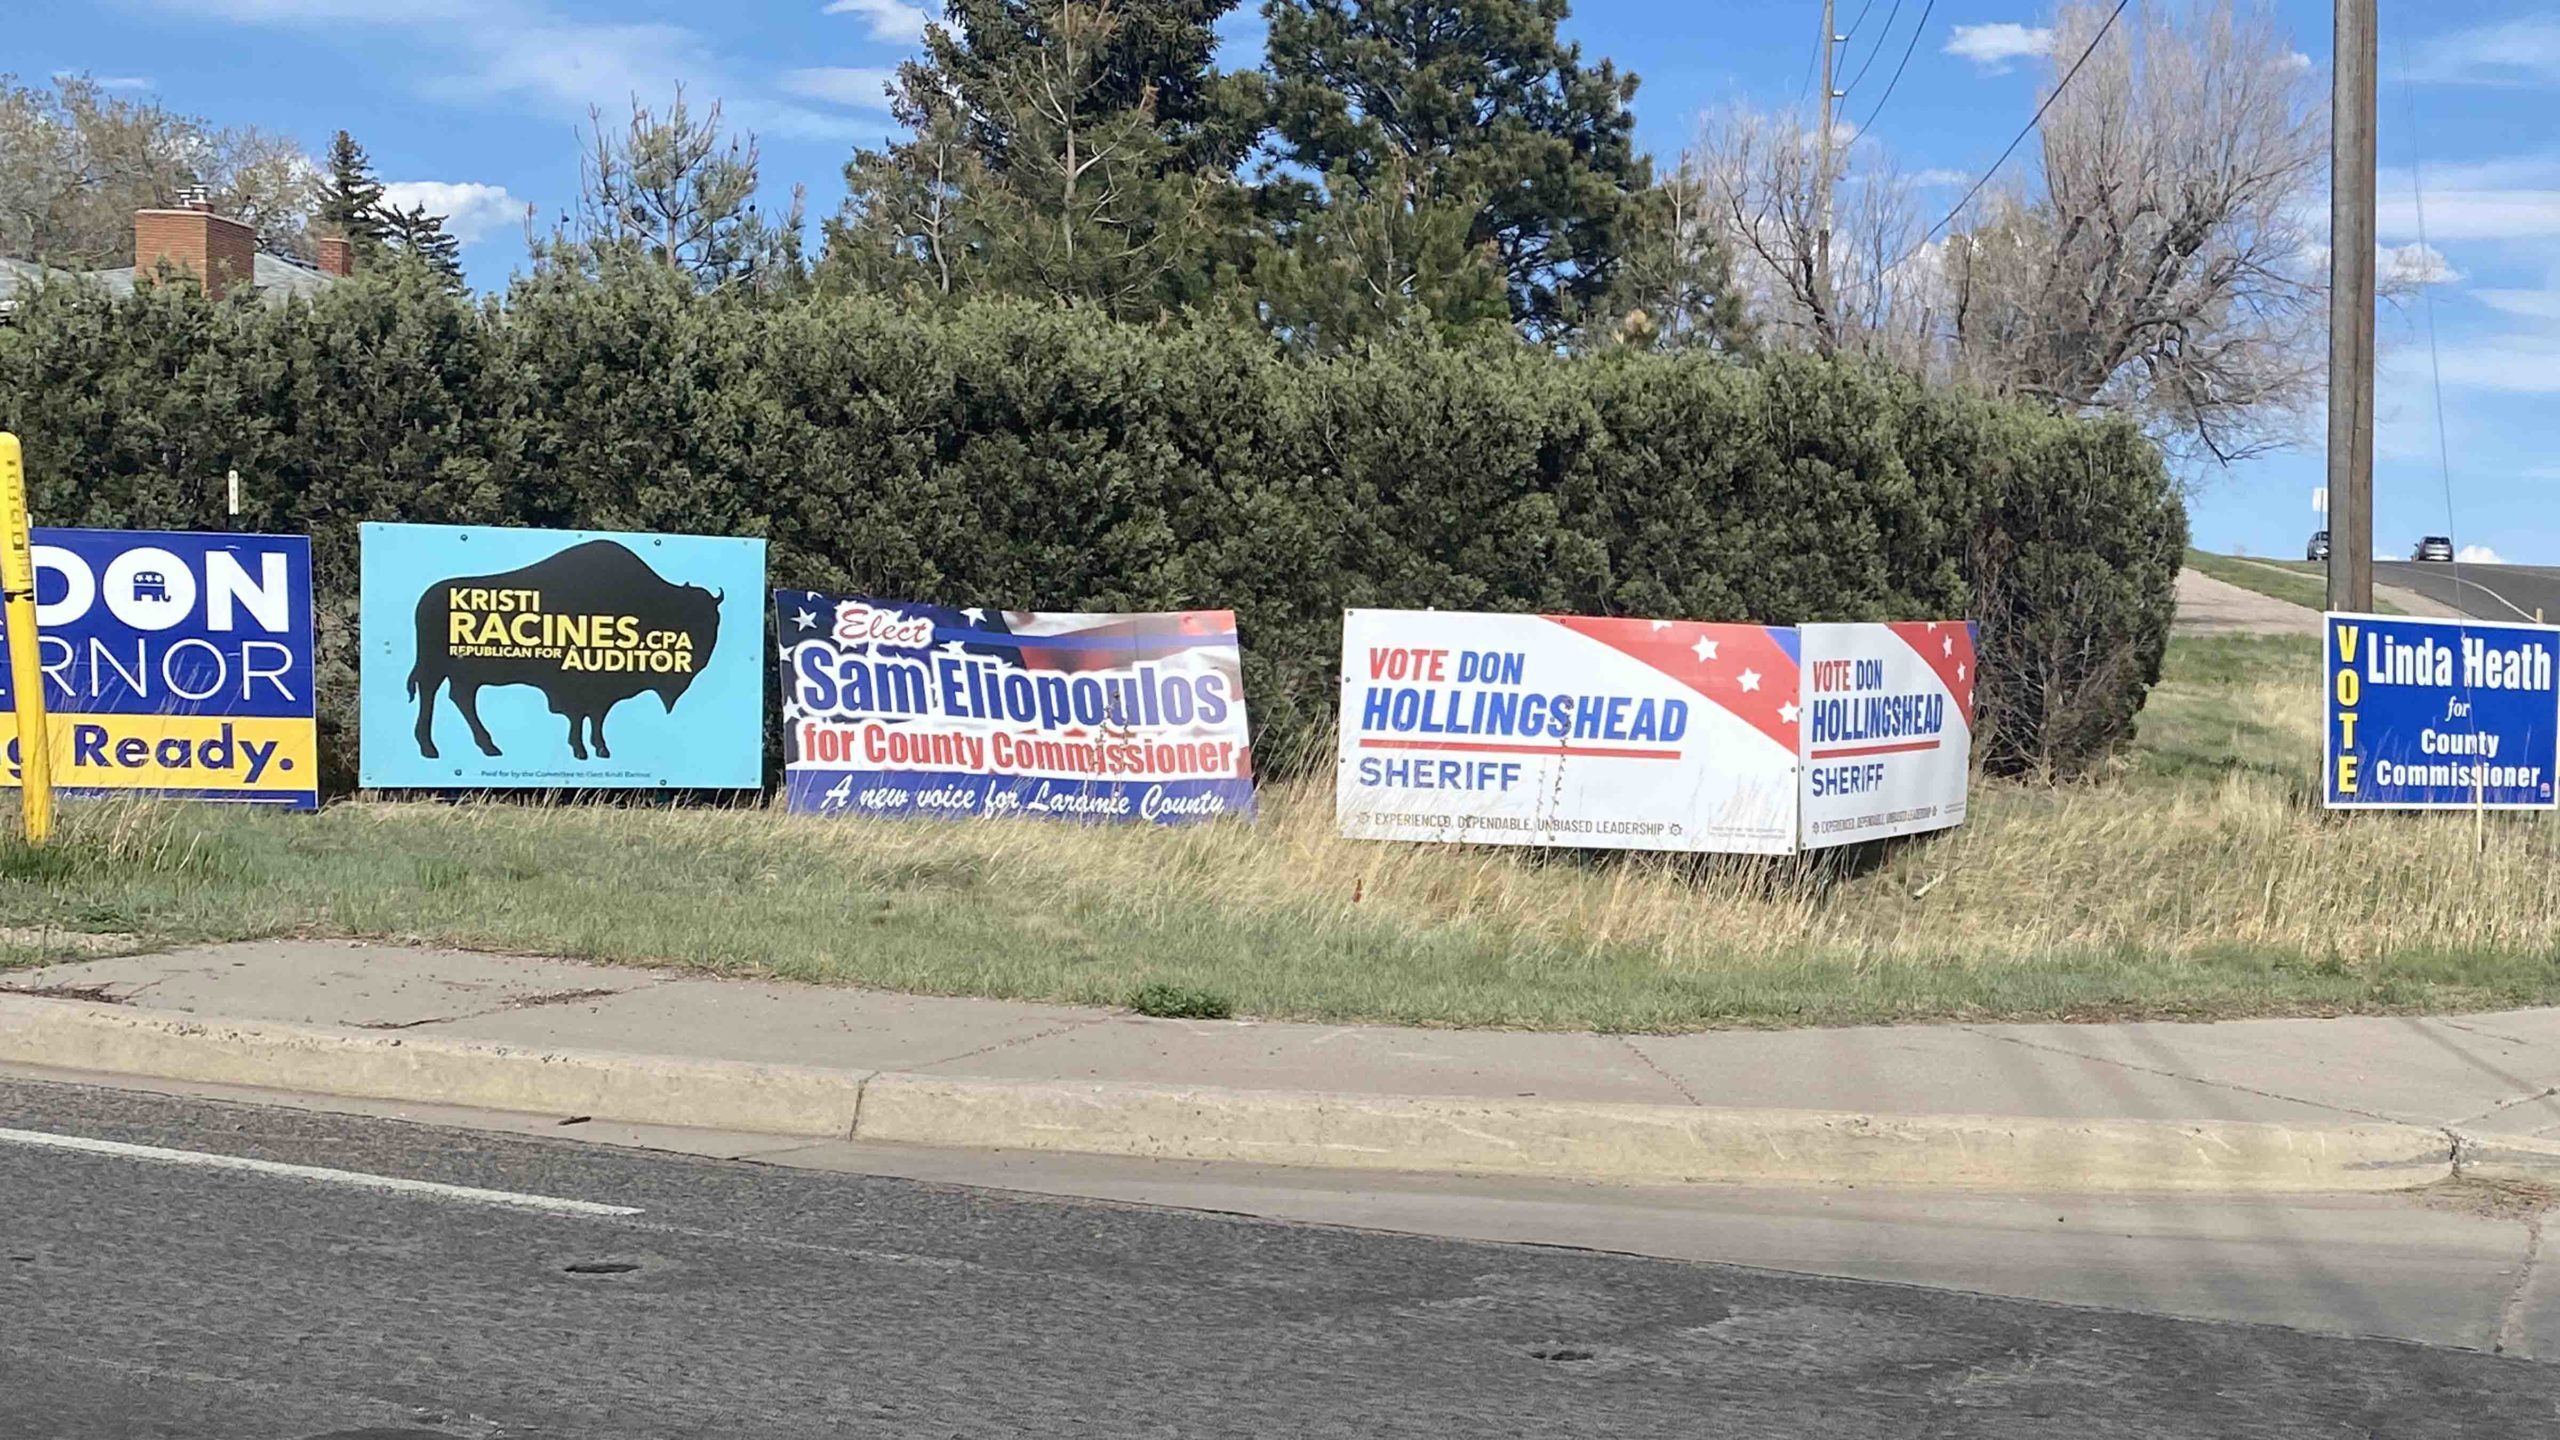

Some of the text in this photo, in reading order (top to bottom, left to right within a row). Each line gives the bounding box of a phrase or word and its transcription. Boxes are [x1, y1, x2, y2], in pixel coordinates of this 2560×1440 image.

[0, 544, 290, 633] DON
[449, 588, 540, 613] KRISTI
[838, 608, 929, 644] Elect
[0, 636, 296, 701] RNOR
[449, 645, 693, 673] REPUBLICAN FOR AUDITOR
[1368, 647, 1525, 685] VOTE DON
[1812, 659, 1883, 692] VOTE DON
[2367, 632, 2551, 691] Linda Heath
[802, 646, 1228, 730] Sam Eliopoulos
[1361, 687, 1688, 743] HOLLINGSHEAD
[1811, 693, 1943, 743] HOLLINGSHEAD
[2336, 625, 2360, 794] VOTE
[2445, 696, 2471, 722] for
[73, 722, 294, 784] Ready.
[804, 723, 1234, 774] for County Commissioner
[2420, 728, 2500, 759] County
[1359, 756, 1522, 792] SHERIFF
[1812, 763, 1885, 797] SHERIFF
[2376, 759, 2541, 788] Commissioner
[821, 775, 851, 809] A
[860, 787, 909, 808] new
[917, 782, 976, 809] voice
[984, 780, 1020, 819] for
[1028, 780, 1131, 815] Laramie
[1537, 818, 1593, 834] UNBIASED
[1595, 820, 1665, 836] LEADERSHIP
